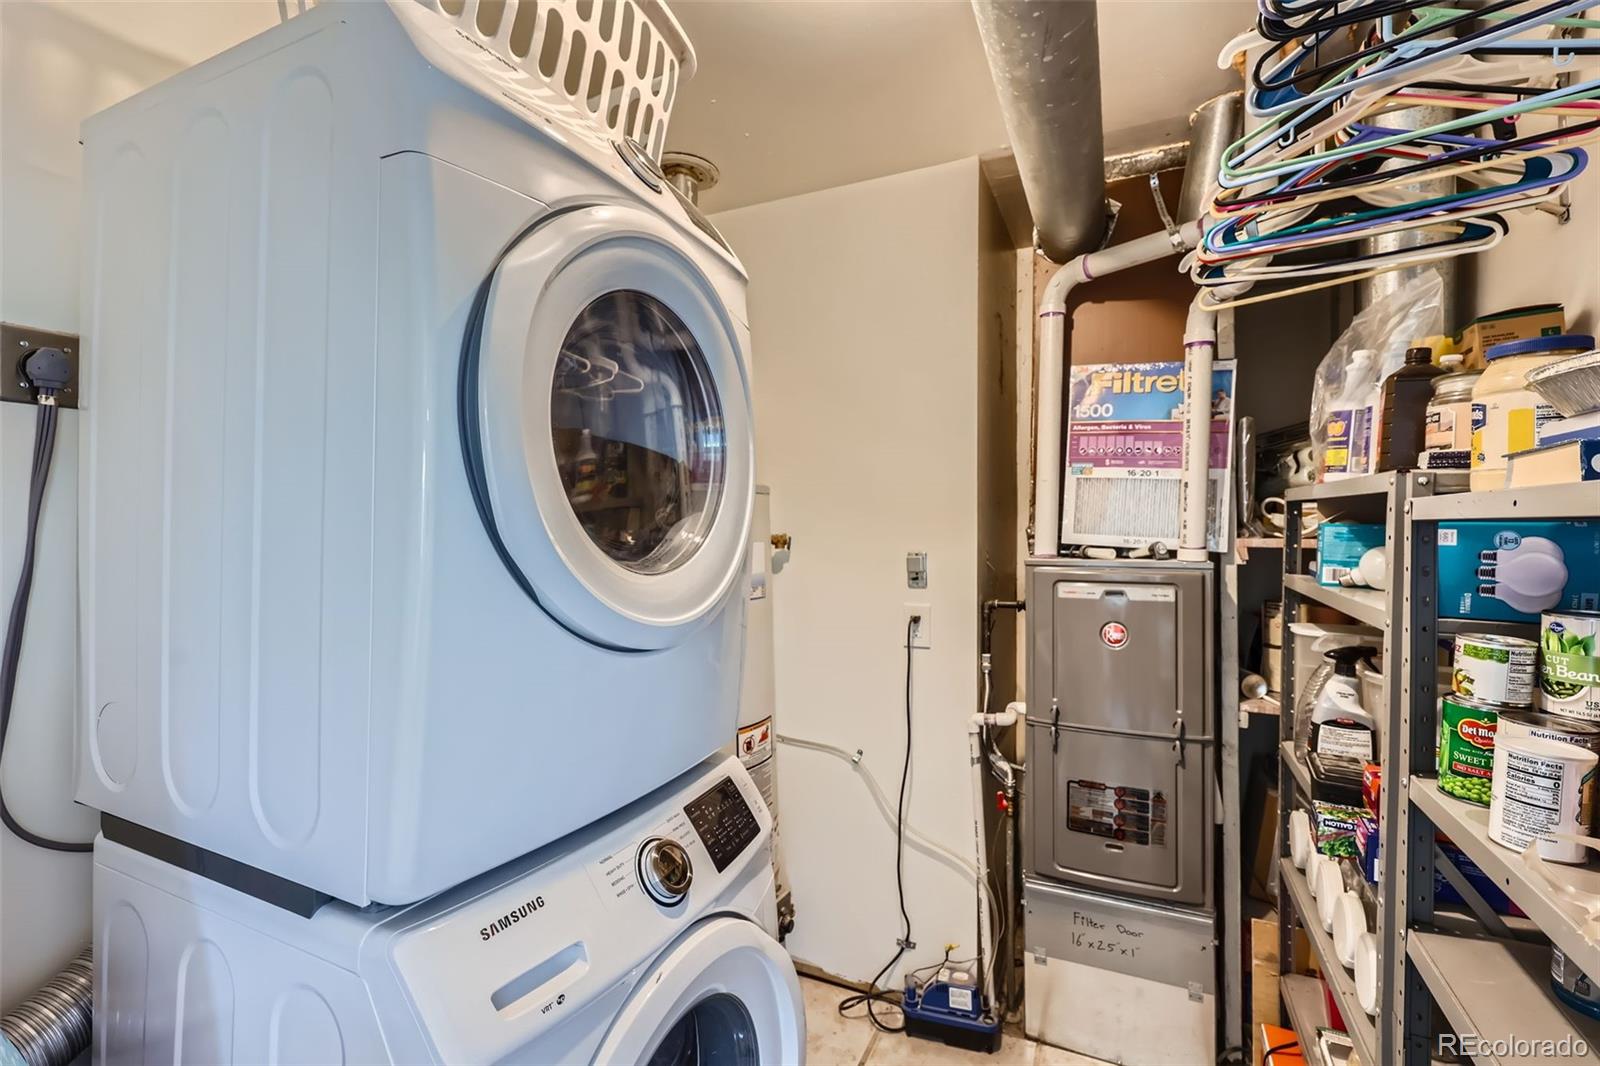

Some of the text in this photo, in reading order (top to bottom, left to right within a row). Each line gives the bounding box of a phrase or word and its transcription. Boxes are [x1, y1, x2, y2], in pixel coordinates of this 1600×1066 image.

[1073, 403, 1113, 418] 1500
[1545, 654, 1570, 665] CUT
[1461, 724, 1477, 735] Del
[1530, 730, 1590, 744] Nutrition Facts
[1453, 751, 1487, 766] SWEET
[1508, 753, 1563, 770] Nutrition Facts
[1467, 767, 1485, 776] SALT
[1506, 772, 1536, 784] Calories
[1553, 781, 1560, 789] 0
[1325, 820, 1354, 830] GALLON
[480, 895, 545, 941] SAMSUNG
[1073, 911, 1144, 938] Filter Door
